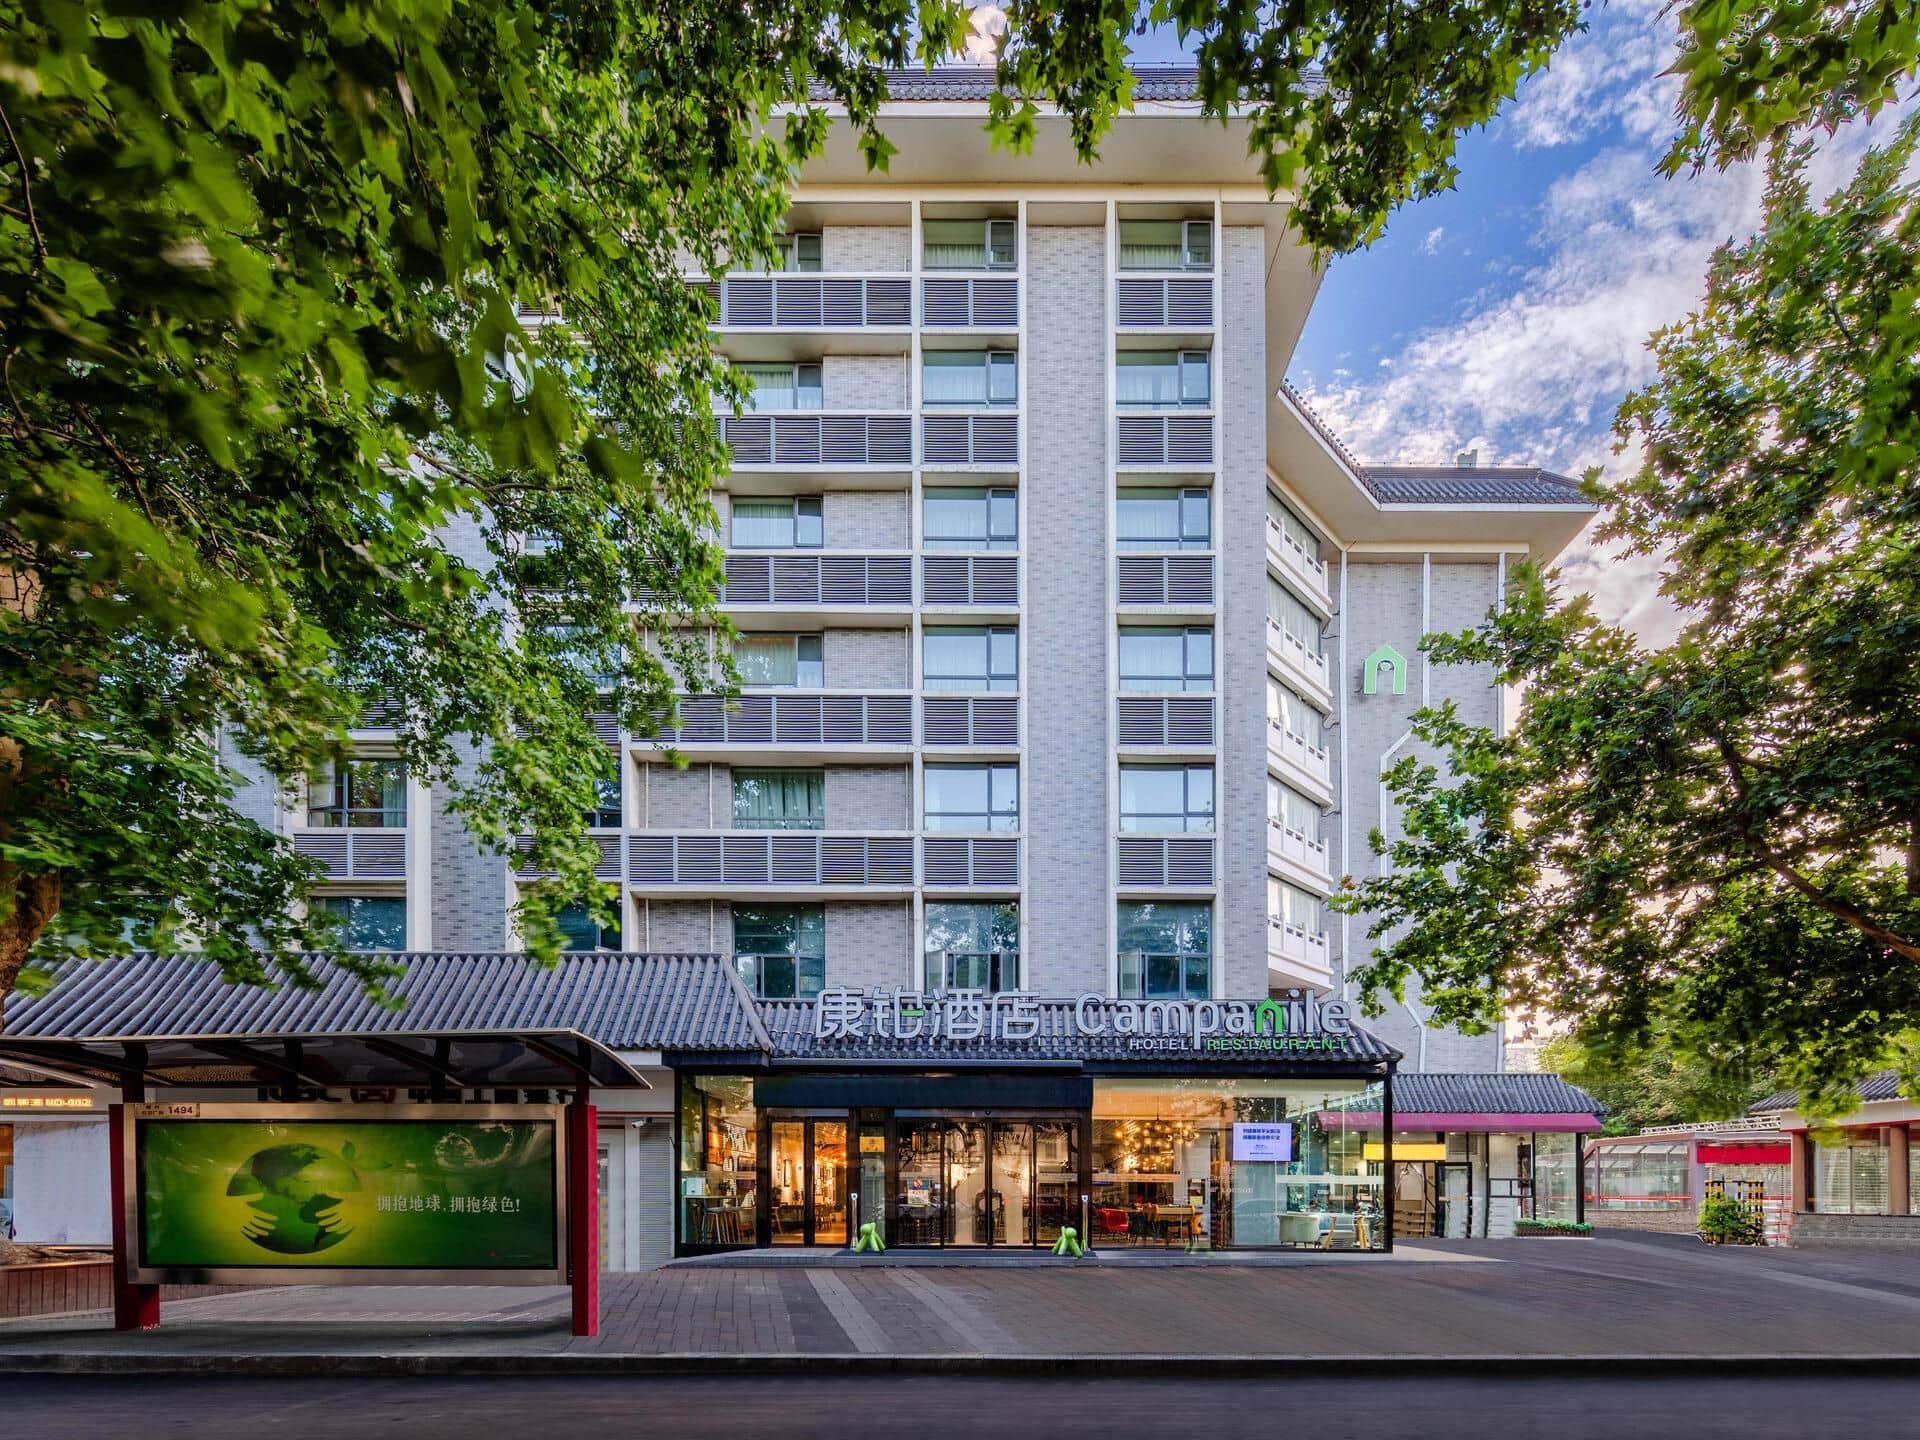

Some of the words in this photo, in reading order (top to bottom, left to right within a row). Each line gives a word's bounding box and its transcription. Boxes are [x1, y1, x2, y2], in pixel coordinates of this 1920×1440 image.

[815, 986, 1040, 1040] 康铂酒店
[1075, 989, 1350, 1050] Campanile
[1129, 1038, 1190, 1050] HOTEL
[1207, 1038, 1347, 1050] RESTAURANT
[168, 1106, 193, 1114] 1494
